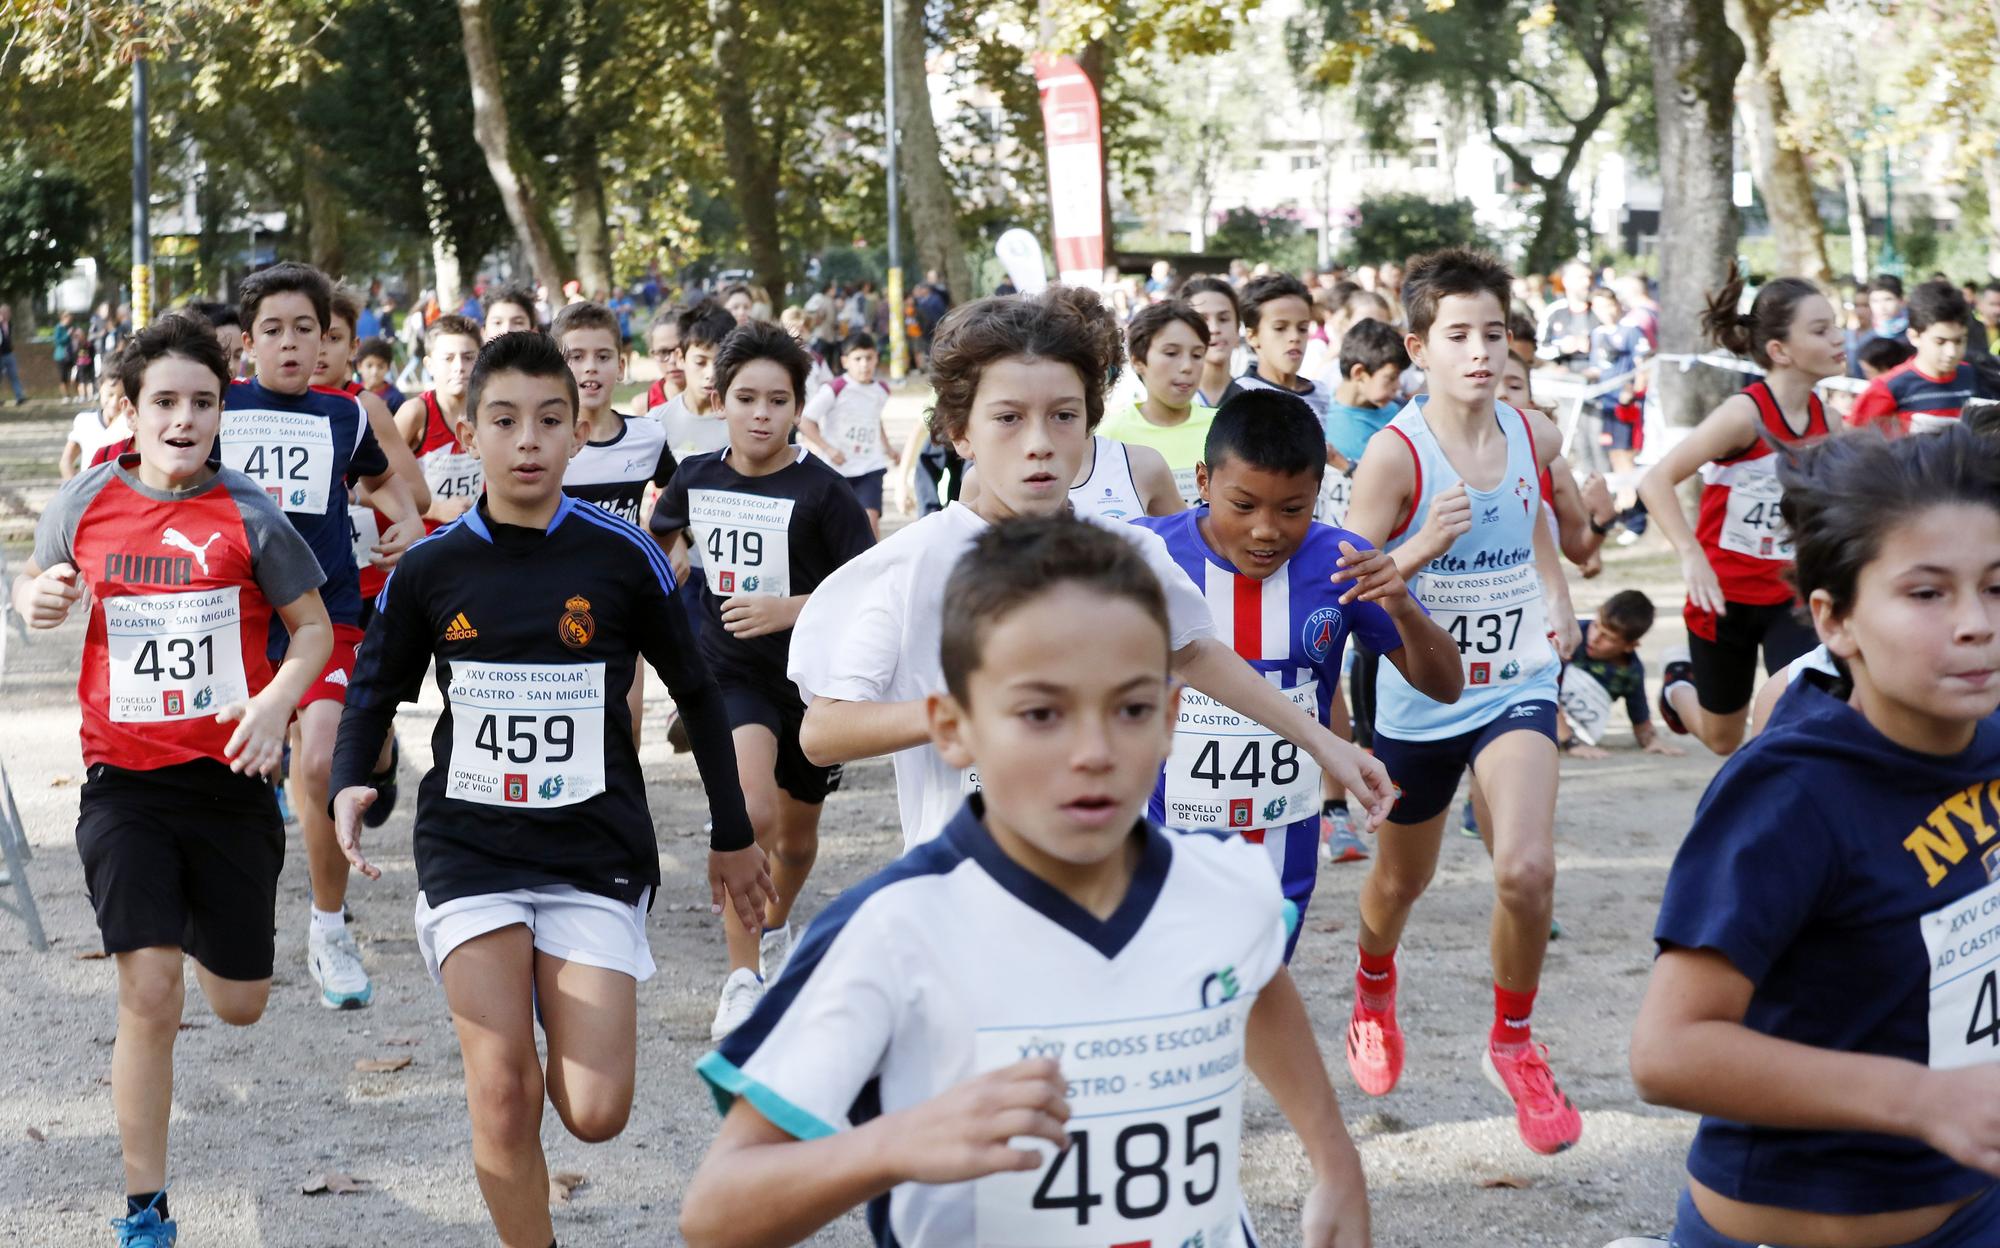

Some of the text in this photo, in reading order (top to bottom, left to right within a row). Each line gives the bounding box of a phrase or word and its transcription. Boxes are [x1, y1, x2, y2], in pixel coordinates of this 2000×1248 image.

[252, 416, 278, 424] CROSS
[281, 417, 315, 426] ESCOLAR
[222, 428, 235, 437] AD
[237, 427, 272, 436] CASTRO
[279, 428, 296, 437] SAN
[299, 429, 328, 439] MIGUEL
[244, 445, 309, 481] 412
[717, 496, 741, 506] CROSS
[742, 499, 778, 509] ESCOLAR
[703, 508, 731, 517] CASTRO
[738, 512, 753, 520] SAN
[755, 514, 785, 524] MIGUEL
[707, 527, 763, 567] 419
[104, 553, 192, 586] PUMA
[1425, 552, 1466, 571] elta
[1433, 580, 1454, 589] XXV
[1457, 578, 1490, 589] CROSS
[141, 601, 175, 612] CROSS
[178, 595, 223, 609] ESCOLAR
[1420, 594, 1436, 603] AD
[1438, 594, 1480, 604] CASTRO
[1489, 591, 1509, 602] SAN
[110, 618, 122, 628] AD
[124, 617, 166, 628] CASTRO
[176, 616, 198, 625] SAN
[201, 608, 236, 624] MIGUEL
[1311, 609, 1341, 625] PARIS
[445, 628, 478, 641] adidas
[1449, 607, 1523, 655] 437
[134, 634, 214, 682] 431
[466, 669, 583, 683] XXV CROSS ESCOLAR
[116, 696, 157, 704] CONCELLO
[452, 686, 467, 696] AD
[469, 688, 515, 701] CASTRO
[527, 690, 552, 701] SAN
[556, 689, 600, 701] MIGUEL
[121, 704, 153, 712] DE VIGO
[1193, 714, 1240, 726] CASTRO
[475, 713, 576, 764] 459
[1190, 739, 1300, 790] 448
[454, 770, 499, 785] CONCELLO
[458, 780, 493, 794] DE VIGO
[1172, 803, 1222, 814] CONCELLO
[1178, 812, 1217, 823] DE VIGO
[1950, 908, 1978, 934] XXV
[1936, 949, 1956, 971] AD
[1074, 1034, 1149, 1061] CROSS
[1156, 1017, 1232, 1051] ESCOLAR
[1065, 1074, 1127, 1100] STRO
[1148, 1067, 1191, 1090] SAN
[1032, 1106, 1222, 1226] 485
